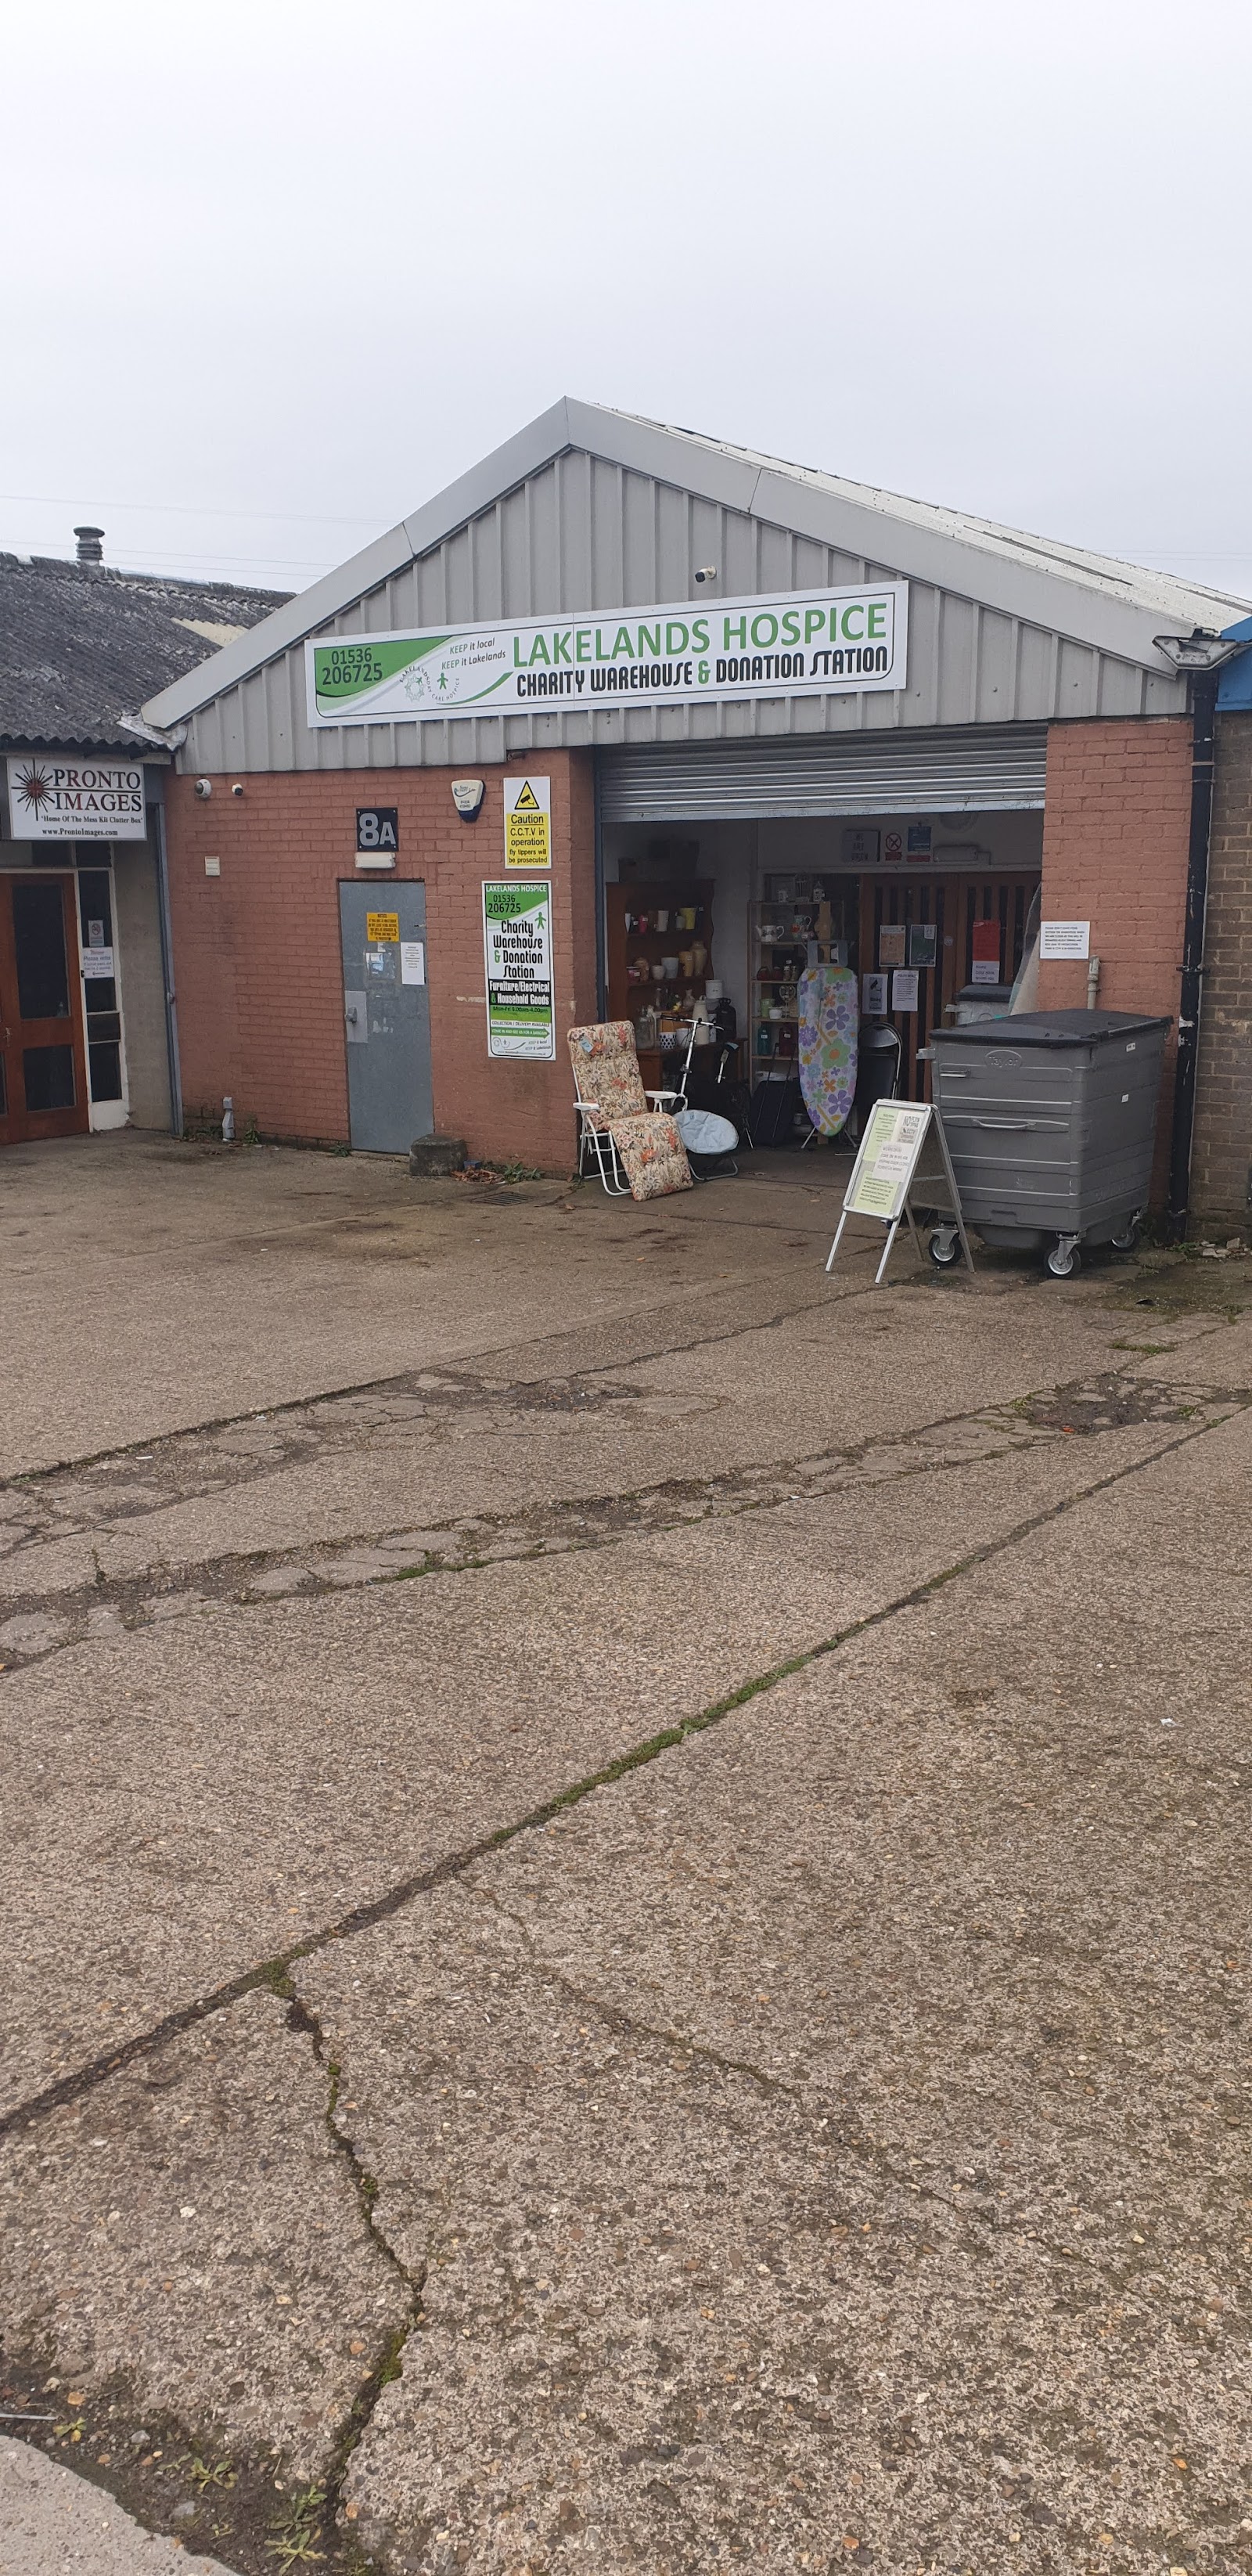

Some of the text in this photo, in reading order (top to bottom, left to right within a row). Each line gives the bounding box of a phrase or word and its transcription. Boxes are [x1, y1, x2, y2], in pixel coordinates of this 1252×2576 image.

[513, 603, 887, 667] LAKELANDS HOSPICE
[449, 637, 495, 654] KEEP it local
[331, 647, 372, 665] 01536
[441, 650, 505, 670] KEEP it Lakelands
[322, 663, 383, 686] 206725
[516, 646, 887, 697] CHARITY WAREHOUSE & DONATION STATION
[446, 678, 460, 701] HOSPICE
[53, 769, 141, 789] PRONTO
[55, 792, 142, 812] IMAGES
[510, 814, 544, 823] Caution
[359, 812, 397, 846] 8A
[538, 827, 545, 836] in
[510, 838, 545, 847] operation
[488, 903, 521, 913] 206725
[501, 919, 534, 937] Charity
[493, 935, 543, 949] Warehouse
[495, 949, 543, 964] & Donation
[503, 965, 534, 978] Station
[490, 980, 550, 993] Furniture/Electrical
[491, 993, 549, 1005] & Household Goods
